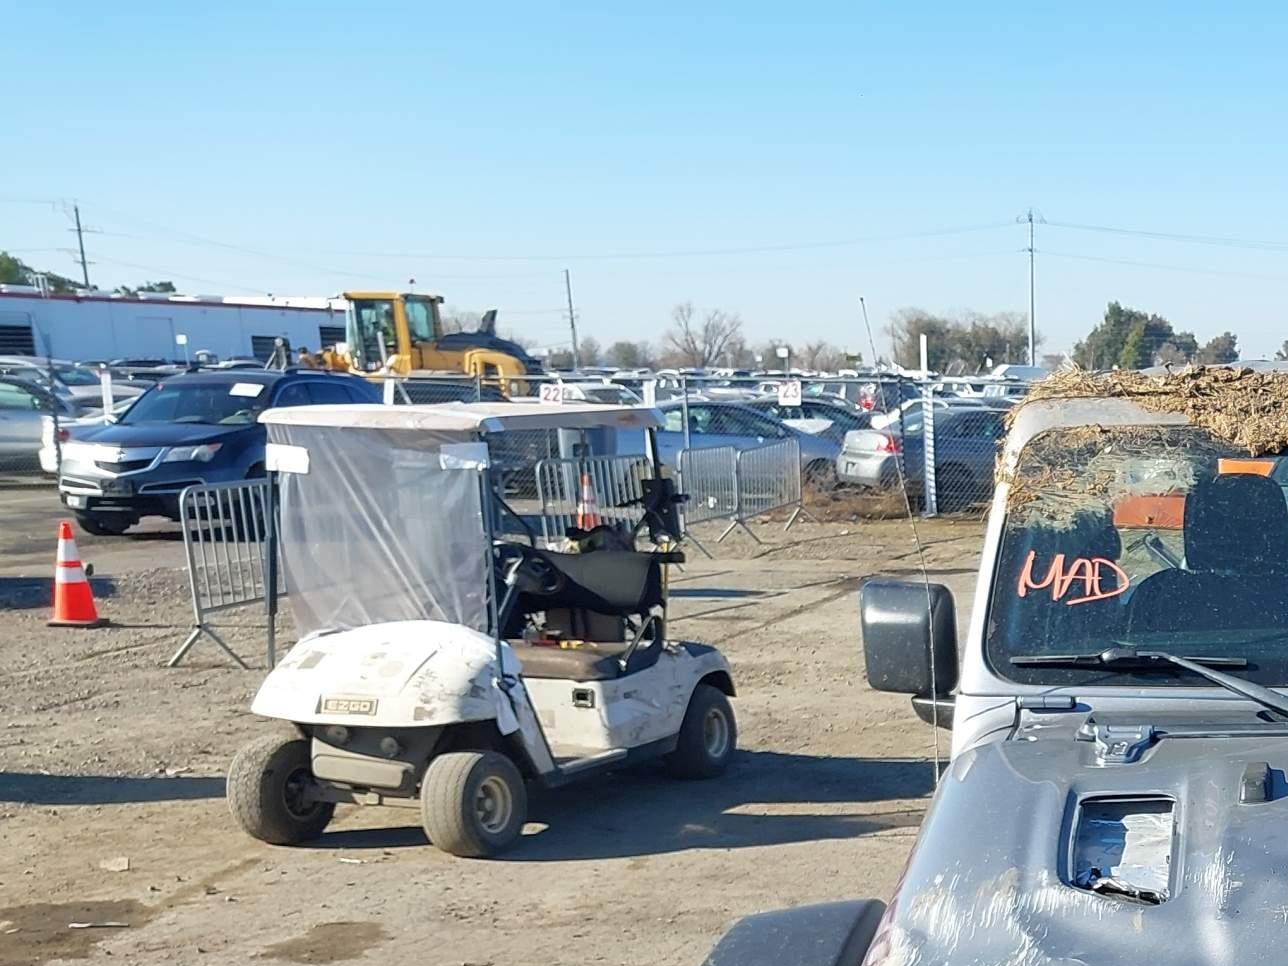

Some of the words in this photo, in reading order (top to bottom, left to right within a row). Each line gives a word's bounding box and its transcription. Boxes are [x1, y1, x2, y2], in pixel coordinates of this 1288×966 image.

[543, 386, 560, 401] 22
[783, 383, 799, 398] 23
[1018, 550, 1130, 605] MAD
